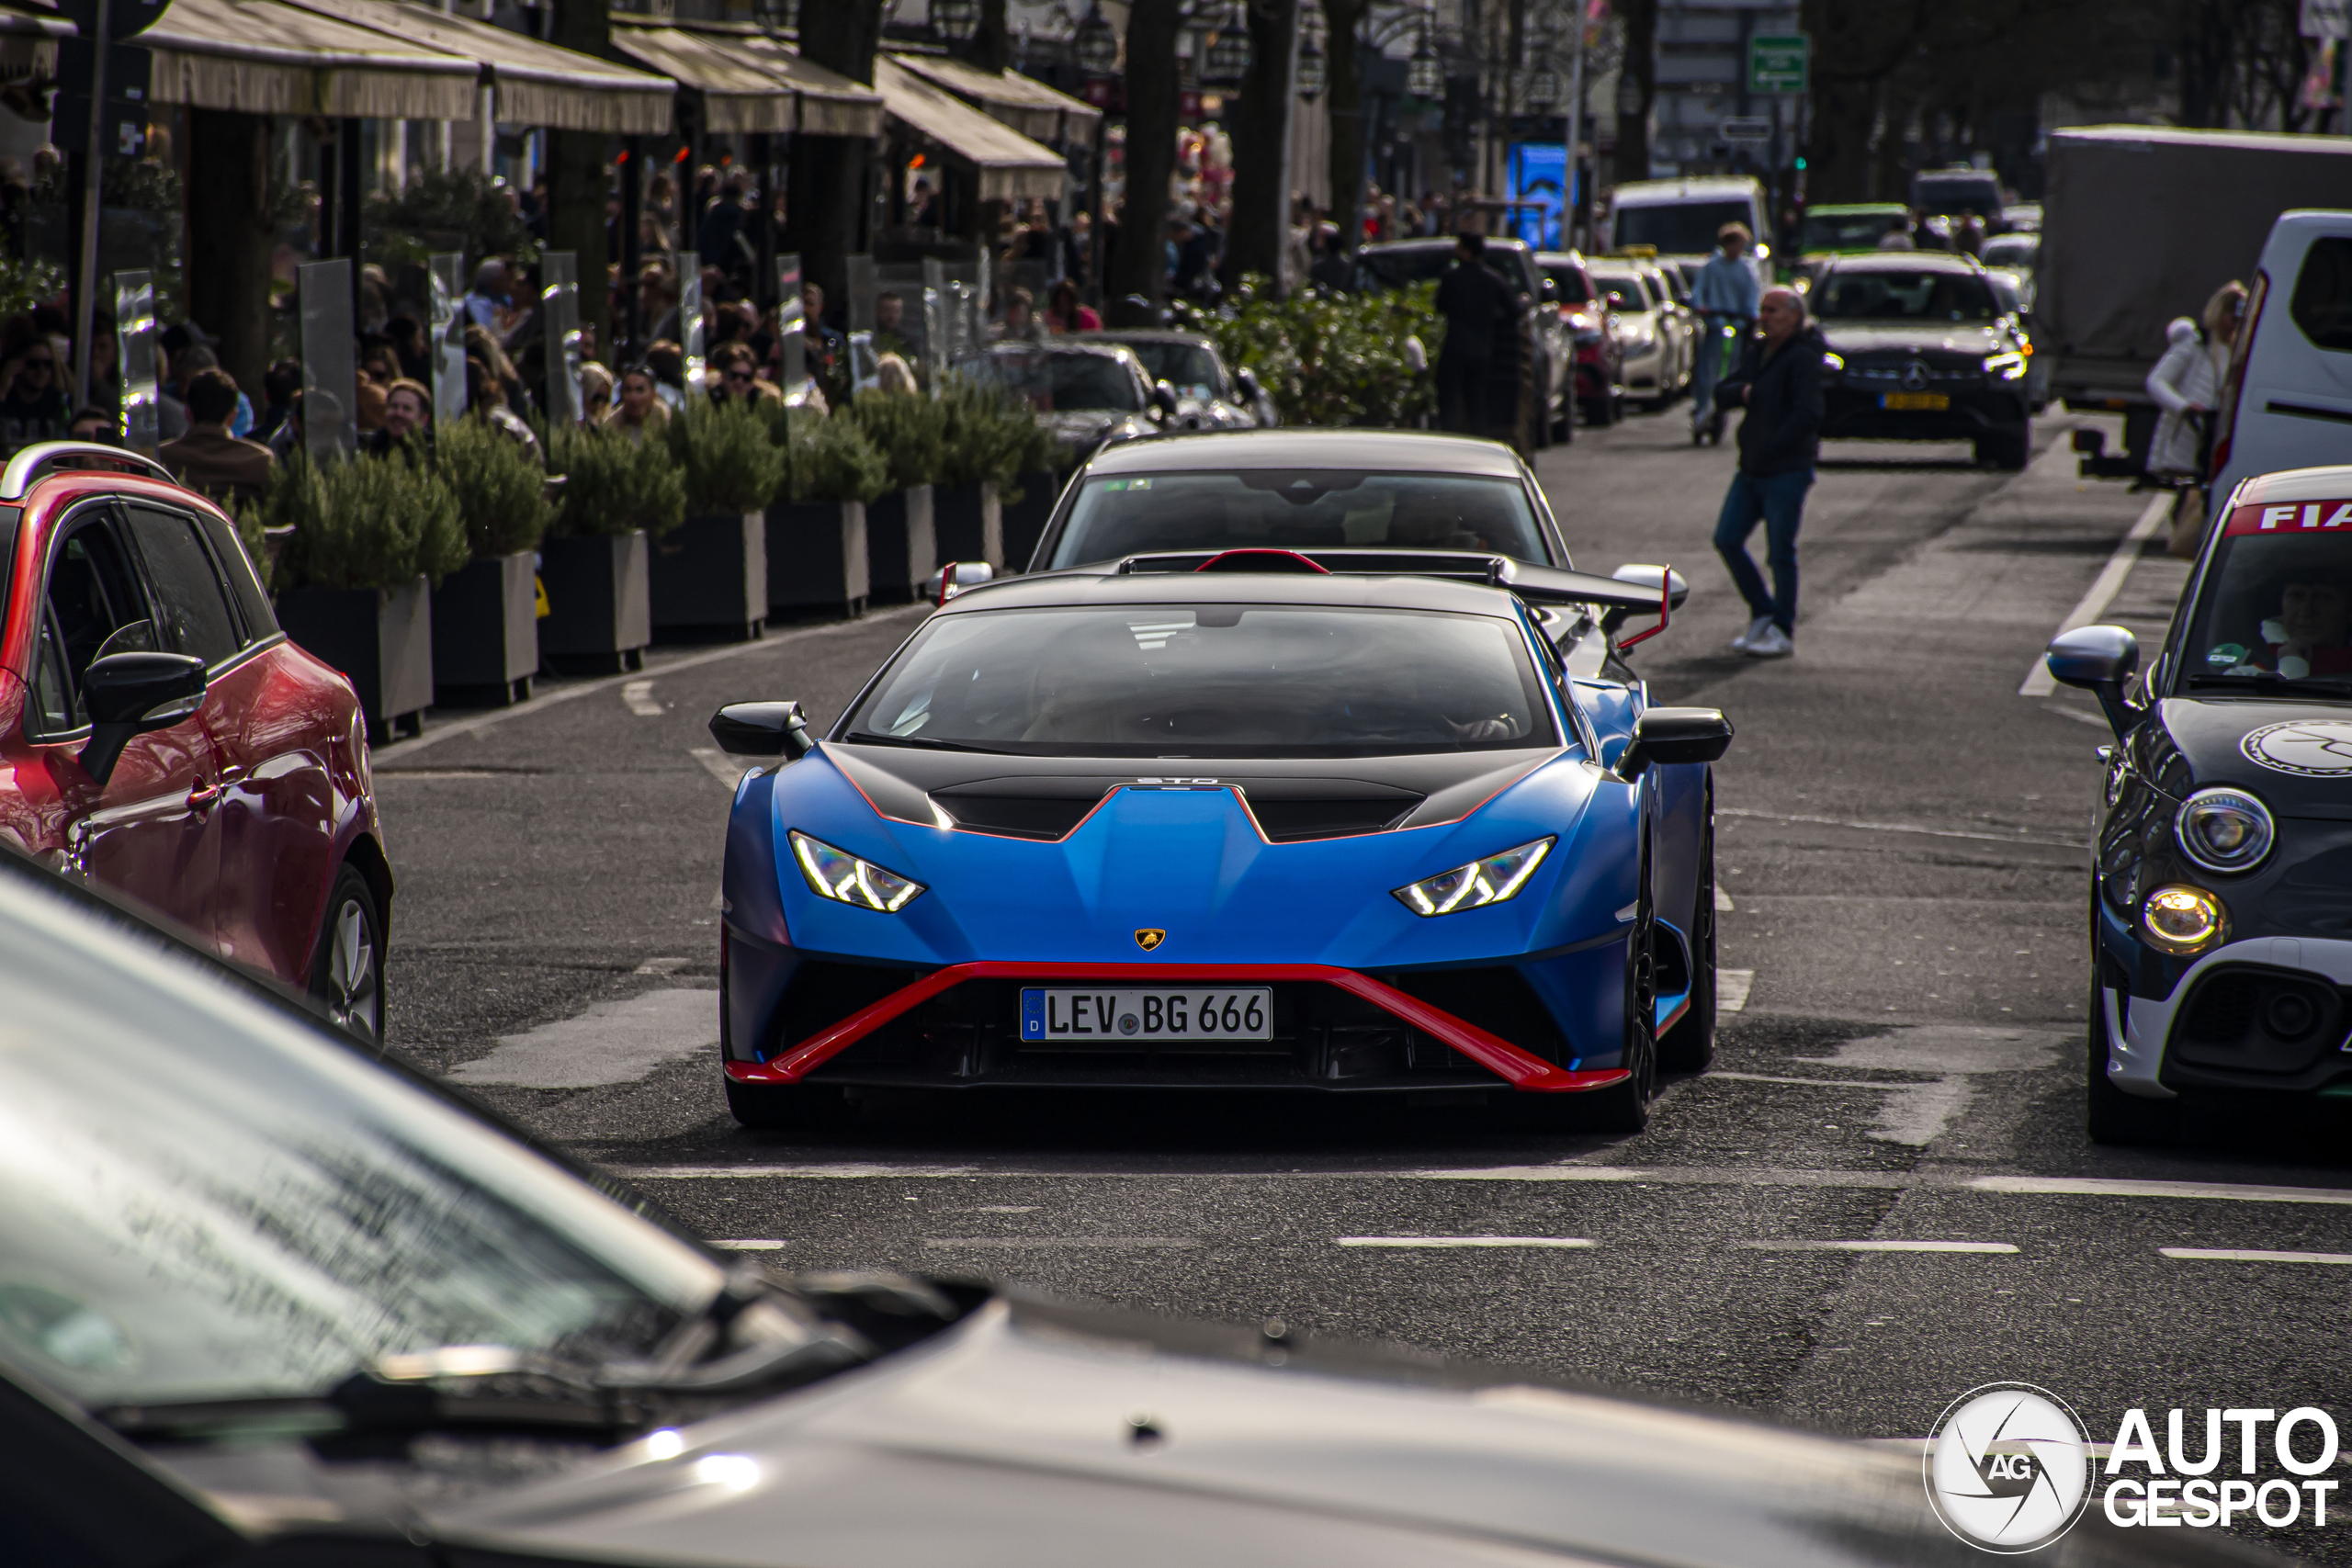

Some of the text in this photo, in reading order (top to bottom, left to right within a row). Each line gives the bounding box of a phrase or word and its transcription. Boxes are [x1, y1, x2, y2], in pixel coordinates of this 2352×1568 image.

[1048, 995, 1264, 1033] LEV BG 666
[1030, 1021, 1039, 1032] D
